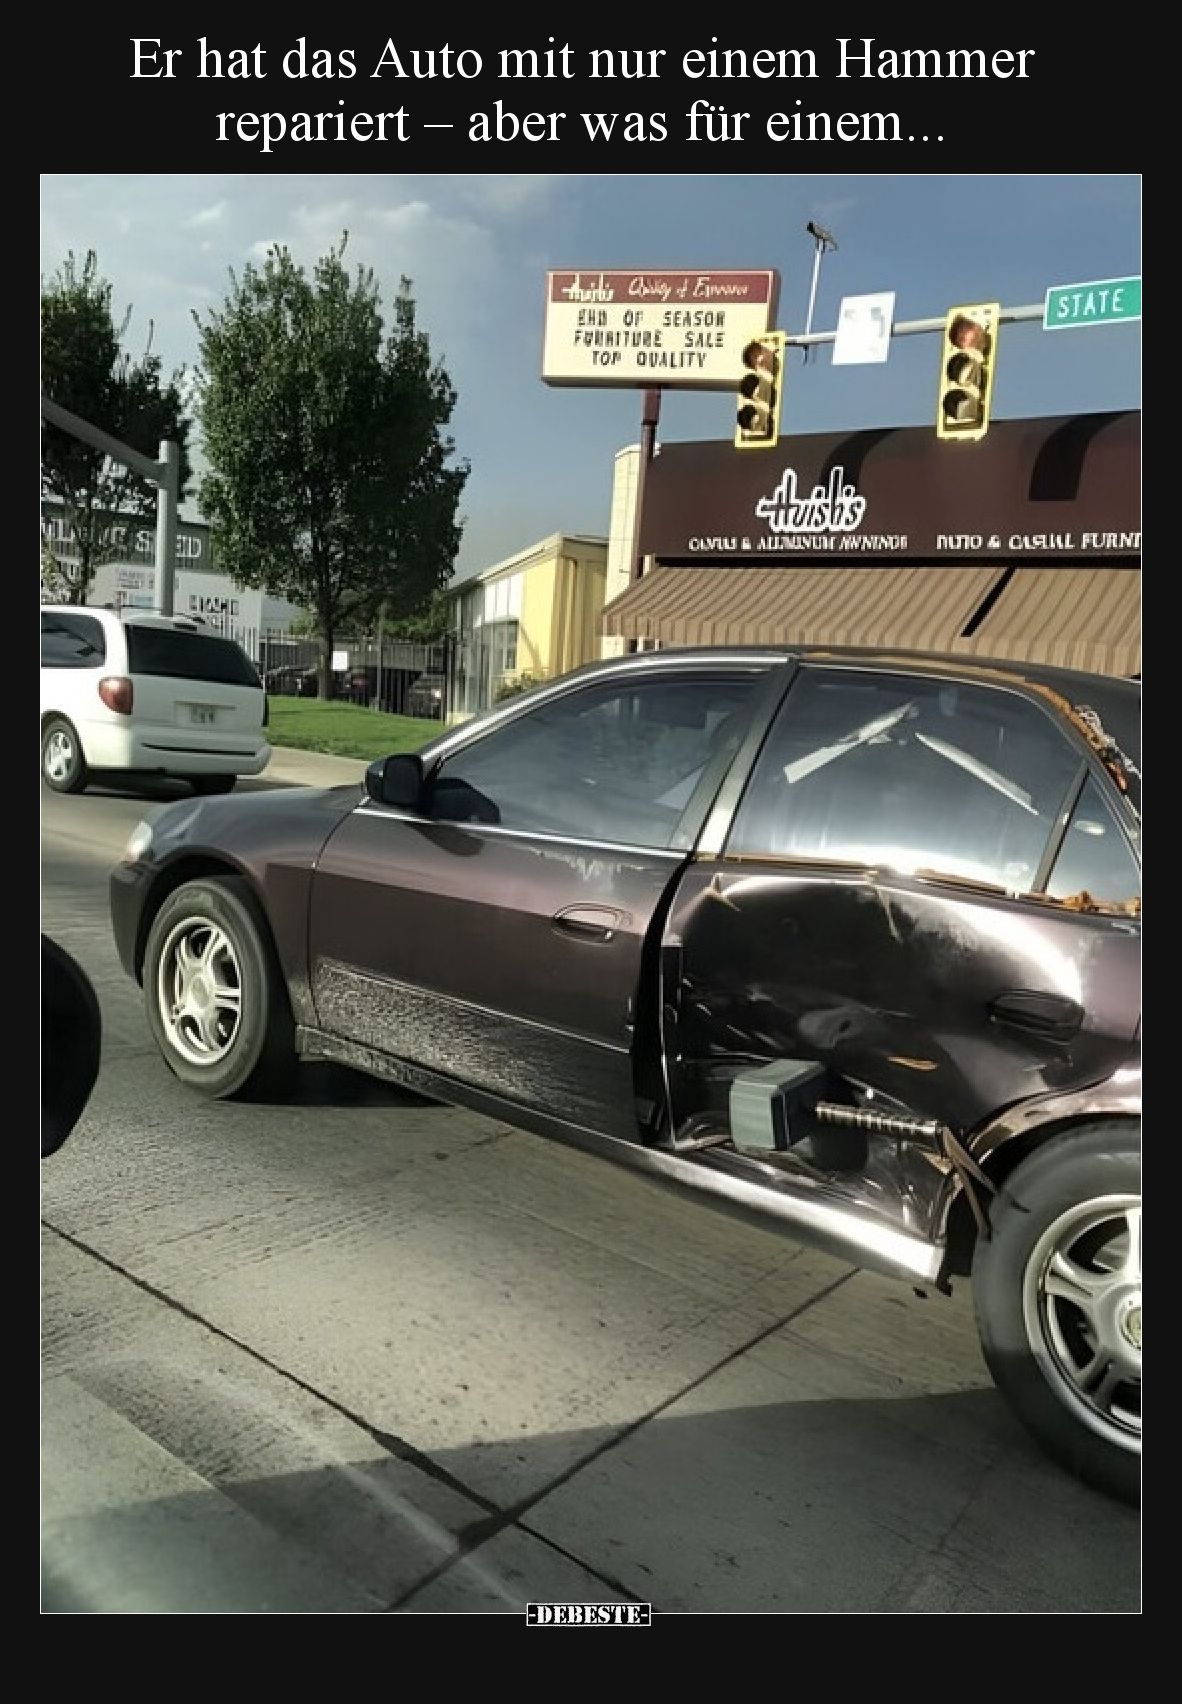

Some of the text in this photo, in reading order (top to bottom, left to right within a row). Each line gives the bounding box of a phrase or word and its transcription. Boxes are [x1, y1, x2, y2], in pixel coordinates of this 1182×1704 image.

[1057, 288, 1124, 318] STATE
[577, 309, 725, 327] END OF SEASON
[574, 330, 725, 348] FURNITURE SALE
[592, 350, 707, 368] TOP QUALITY
[987, 535, 1001, 550] &
[1008, 533, 1075, 550] CASUAL
